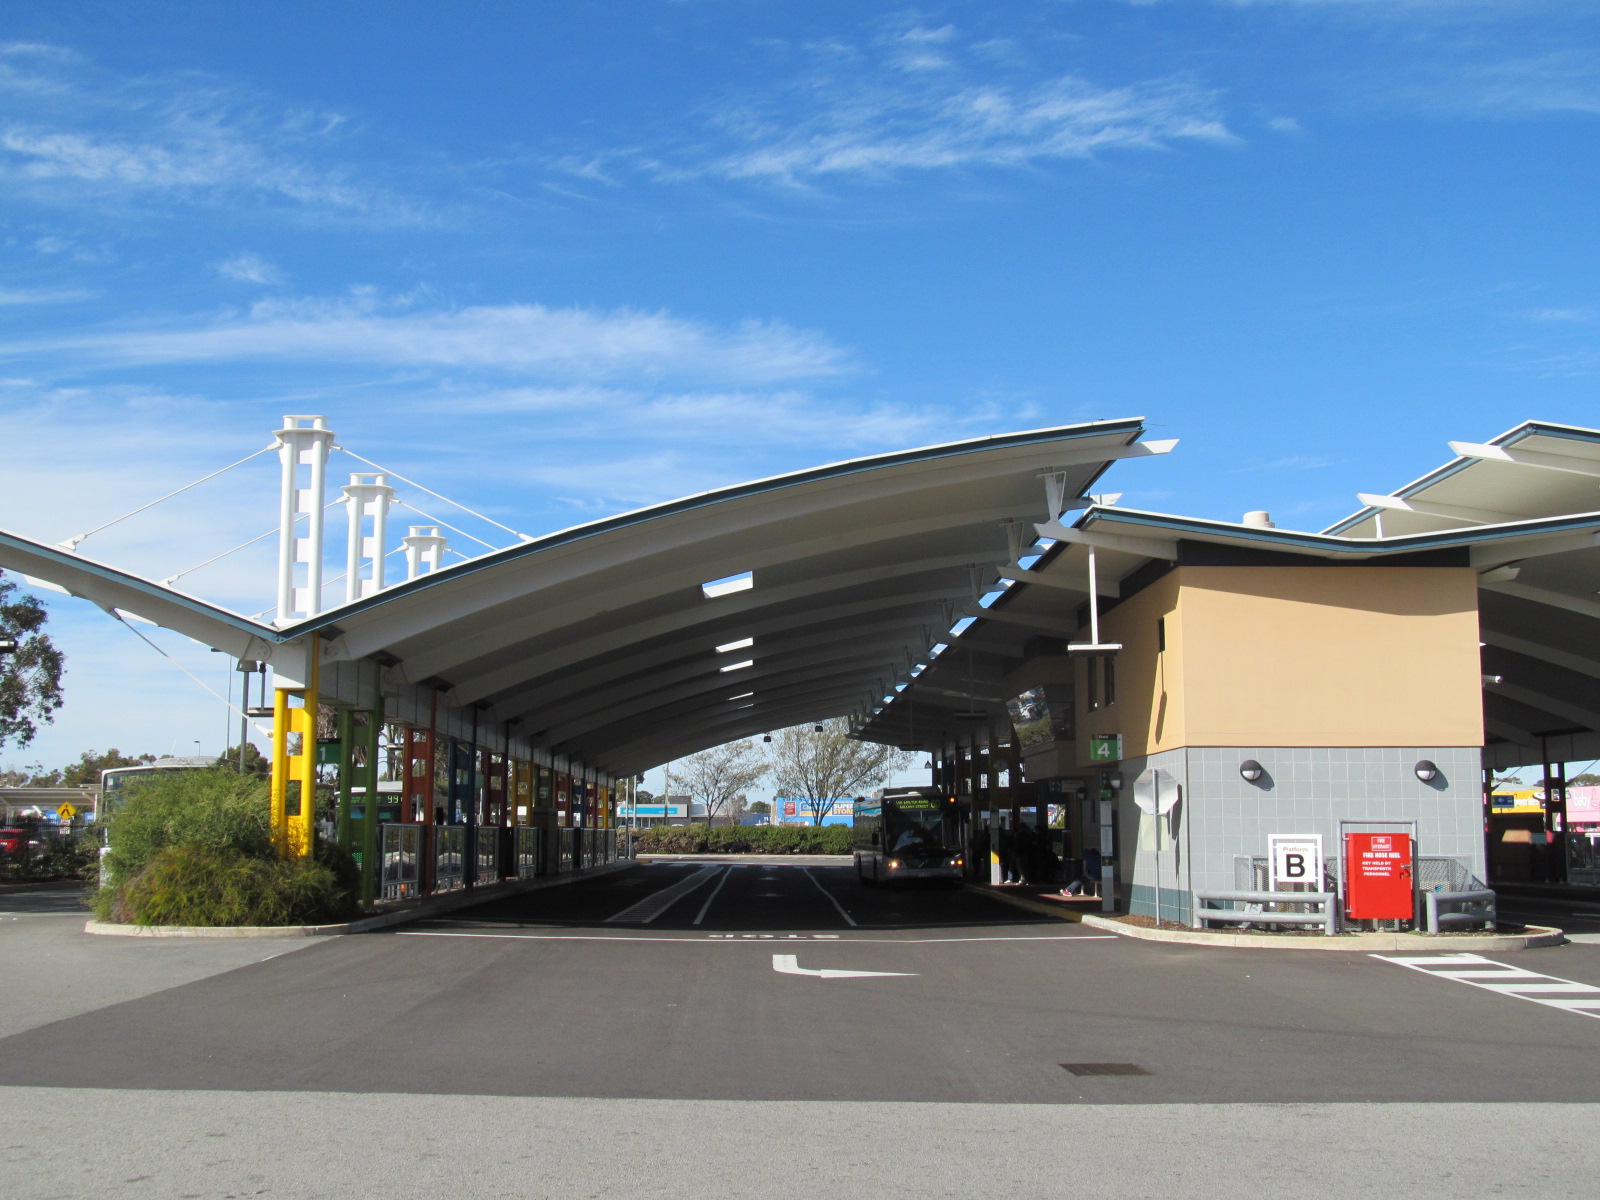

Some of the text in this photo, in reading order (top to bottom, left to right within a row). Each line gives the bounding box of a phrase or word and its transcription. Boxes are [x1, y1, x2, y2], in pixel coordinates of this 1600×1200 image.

[320, 747, 326, 761] 1
[1098, 743, 1110, 757] 4
[1573, 789, 1591, 809] baby
[1286, 854, 1305, 877] B
